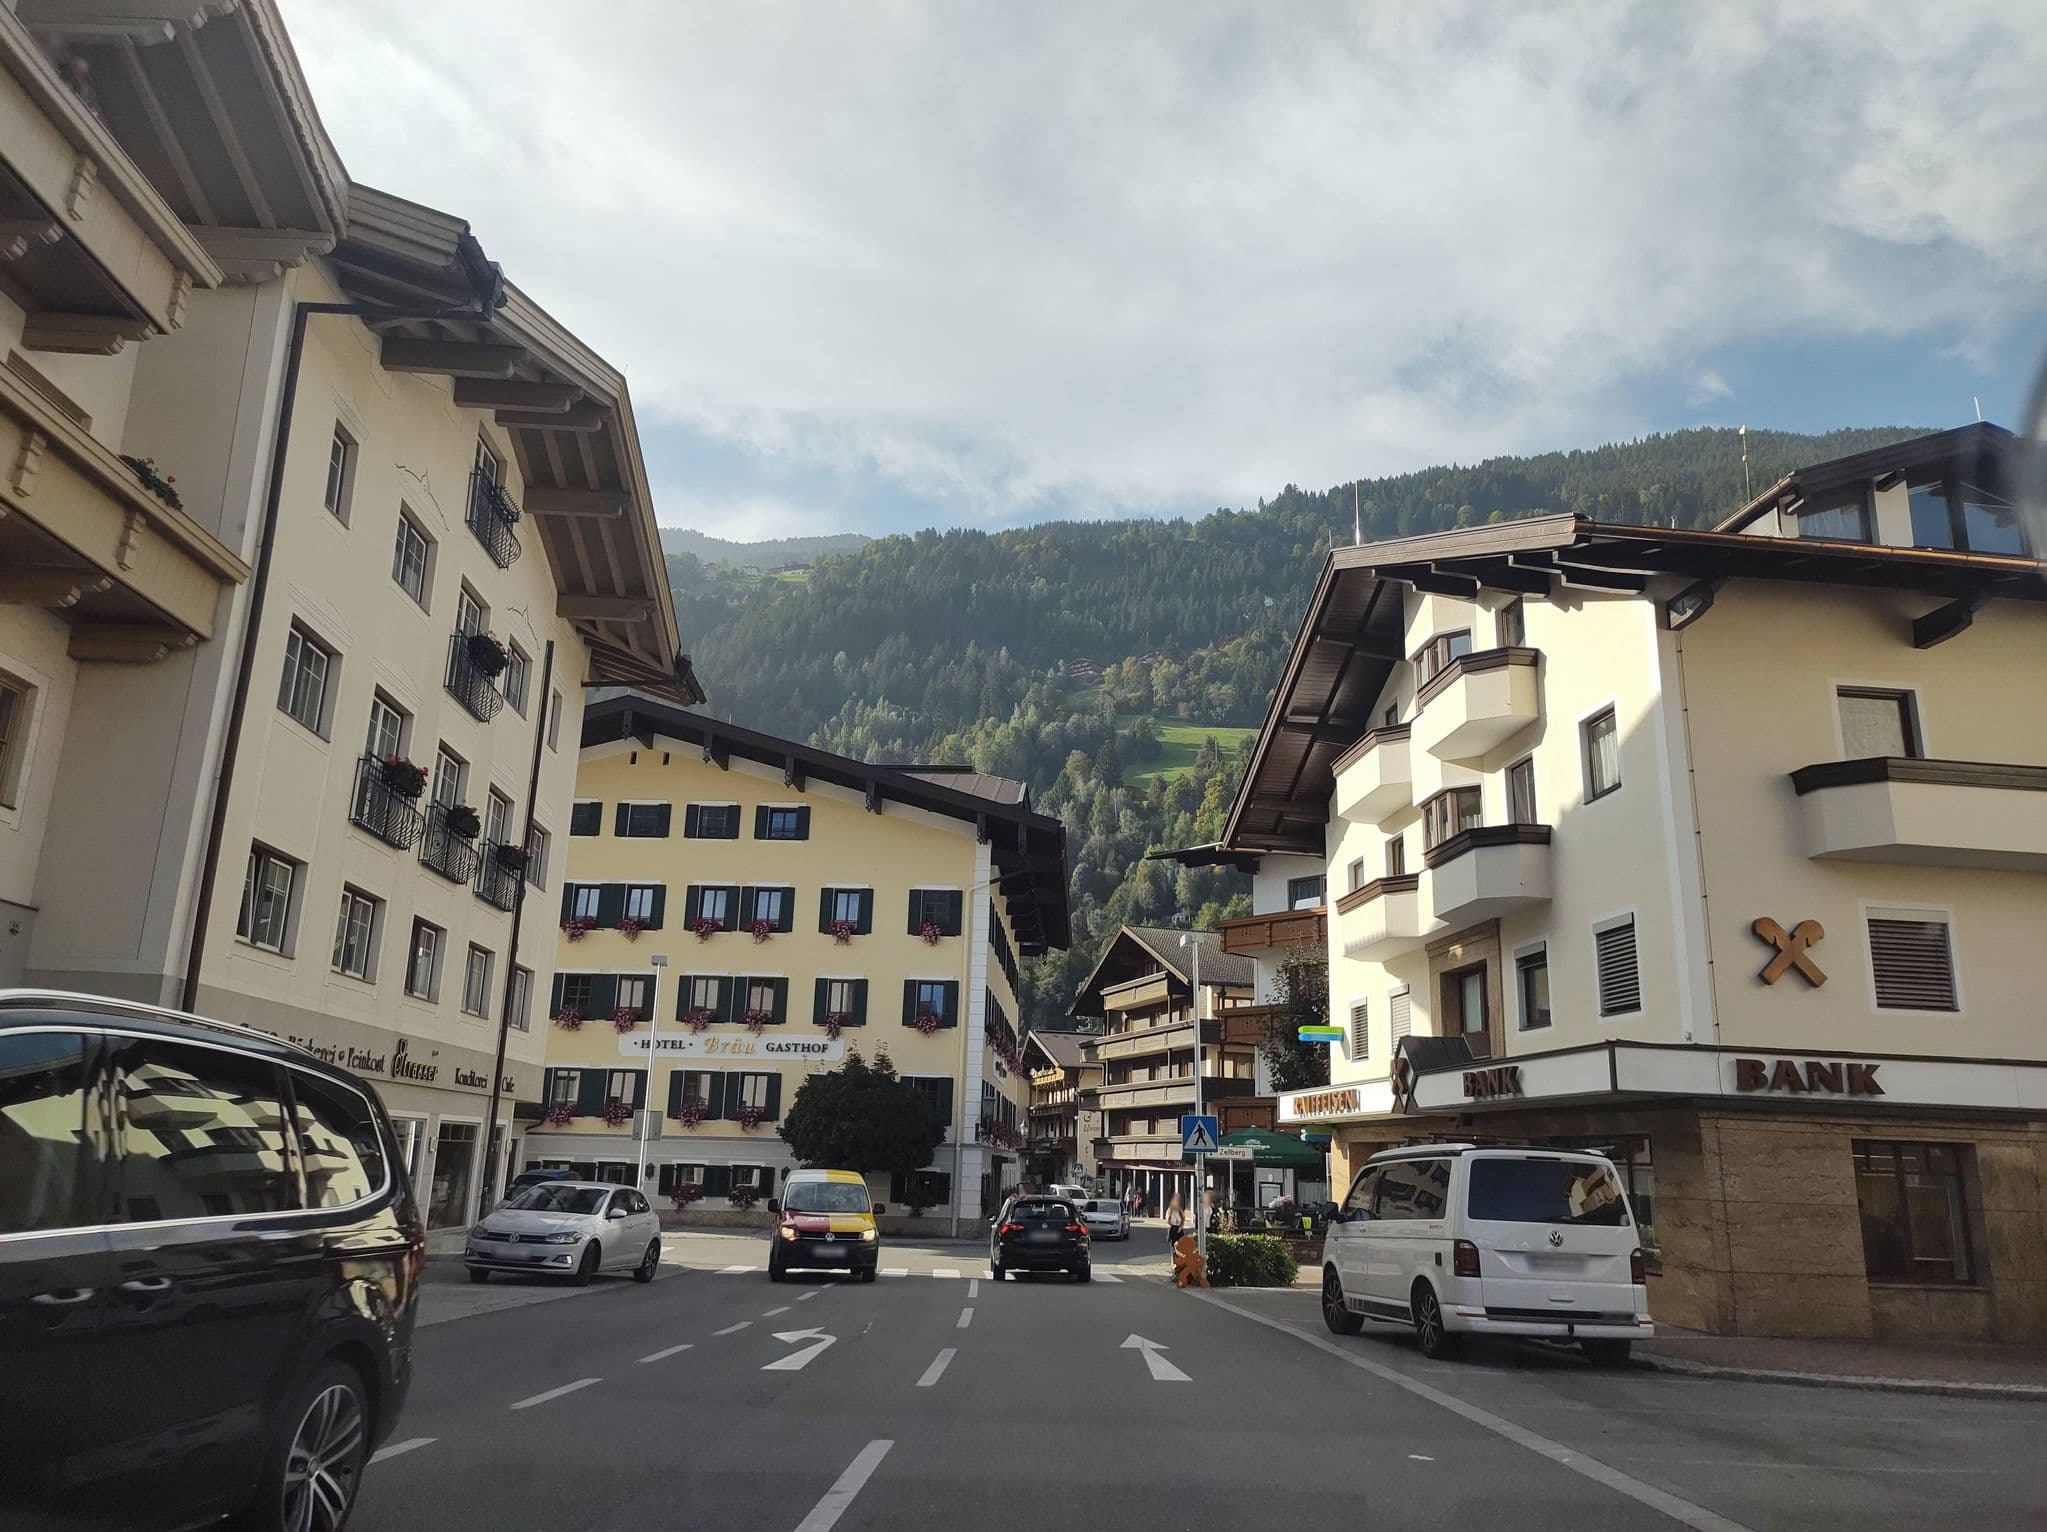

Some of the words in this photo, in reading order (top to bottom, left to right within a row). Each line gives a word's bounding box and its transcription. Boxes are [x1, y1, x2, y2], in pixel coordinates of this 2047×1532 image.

[640, 1039, 686, 1050] HOTEL
[703, 1036, 755, 1056] Bräu
[765, 1041, 829, 1054] GASTHOF
[1463, 1065, 1521, 1098] BANK
[1735, 1058, 1886, 1095] BANK
[1294, 1088, 1358, 1115] RAIFFEISEN
[1219, 1148, 1246, 1158] Zellberg
